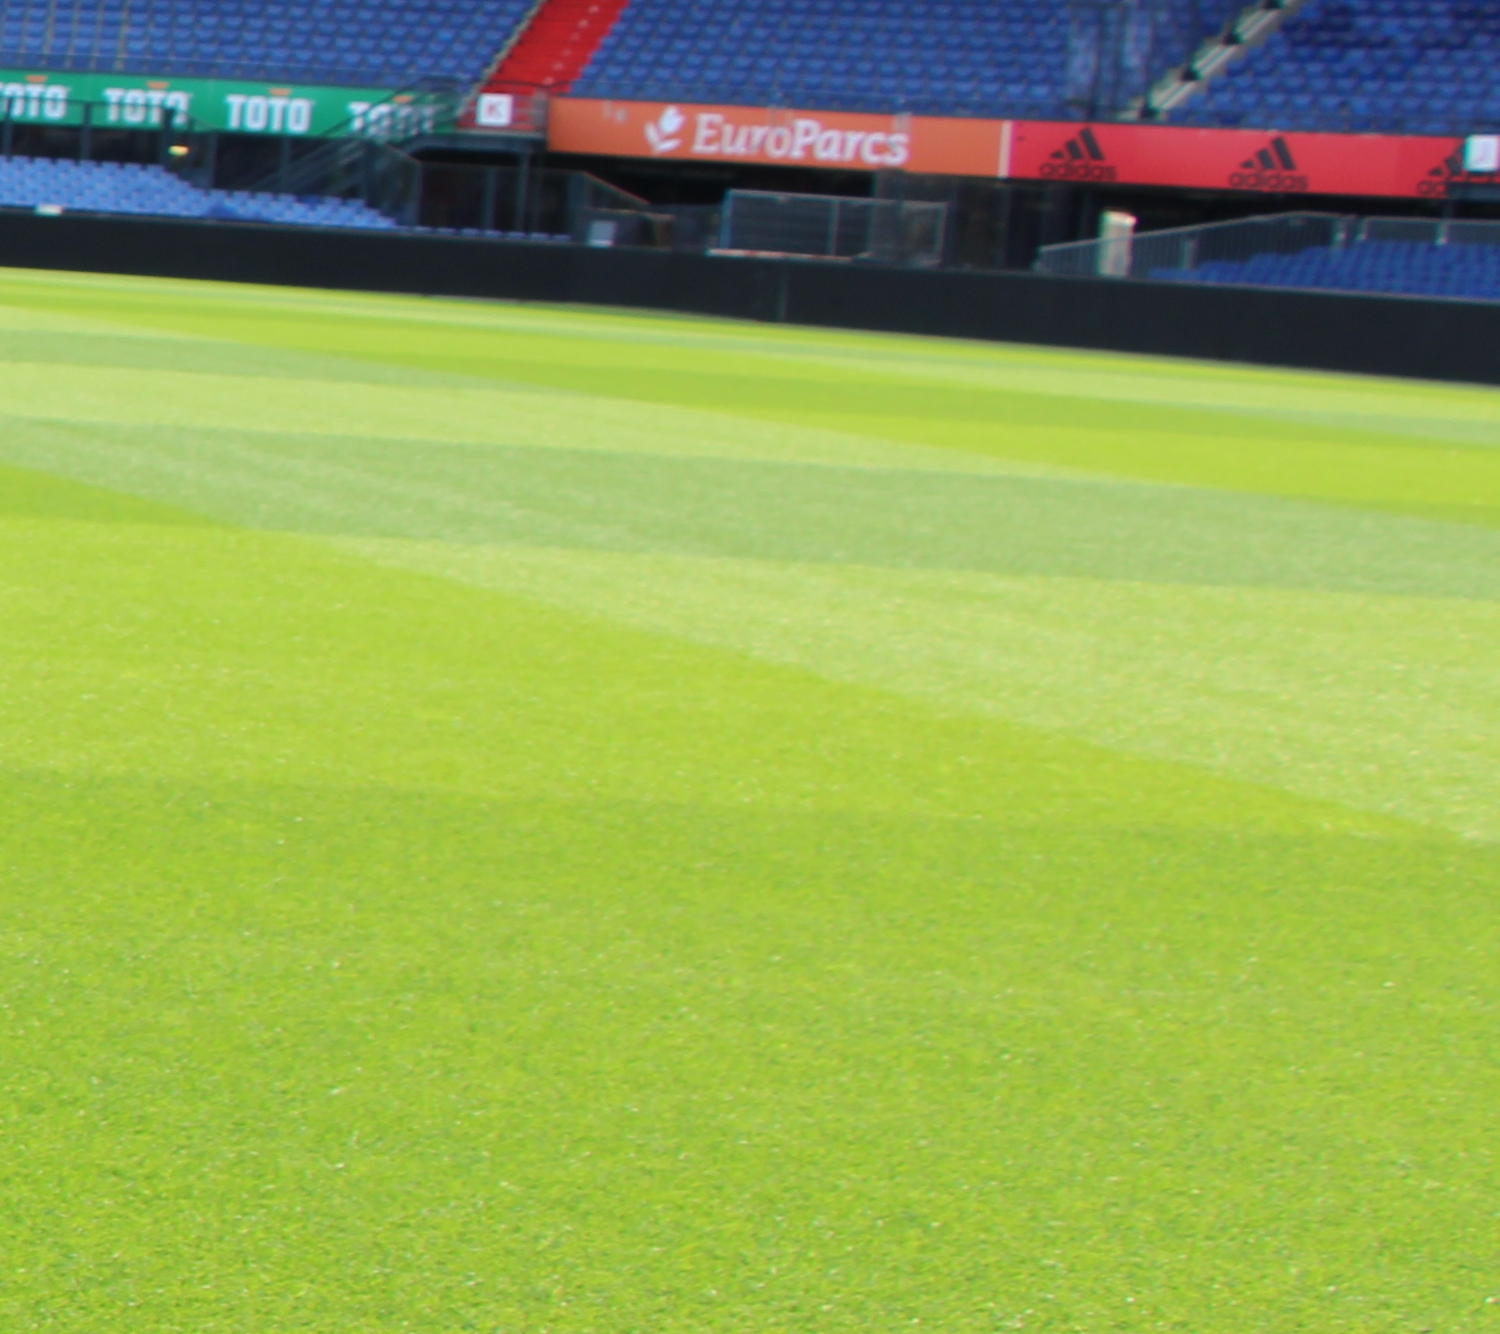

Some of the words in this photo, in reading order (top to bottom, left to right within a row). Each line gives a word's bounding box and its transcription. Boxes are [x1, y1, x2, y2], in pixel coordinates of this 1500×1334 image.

[105, 86, 190, 125] TOTO
[227, 92, 314, 133] TOTO
[691, 112, 910, 165] EuroParcs
[1040, 162, 1117, 182] adidas
[1228, 172, 1309, 192] adidas
